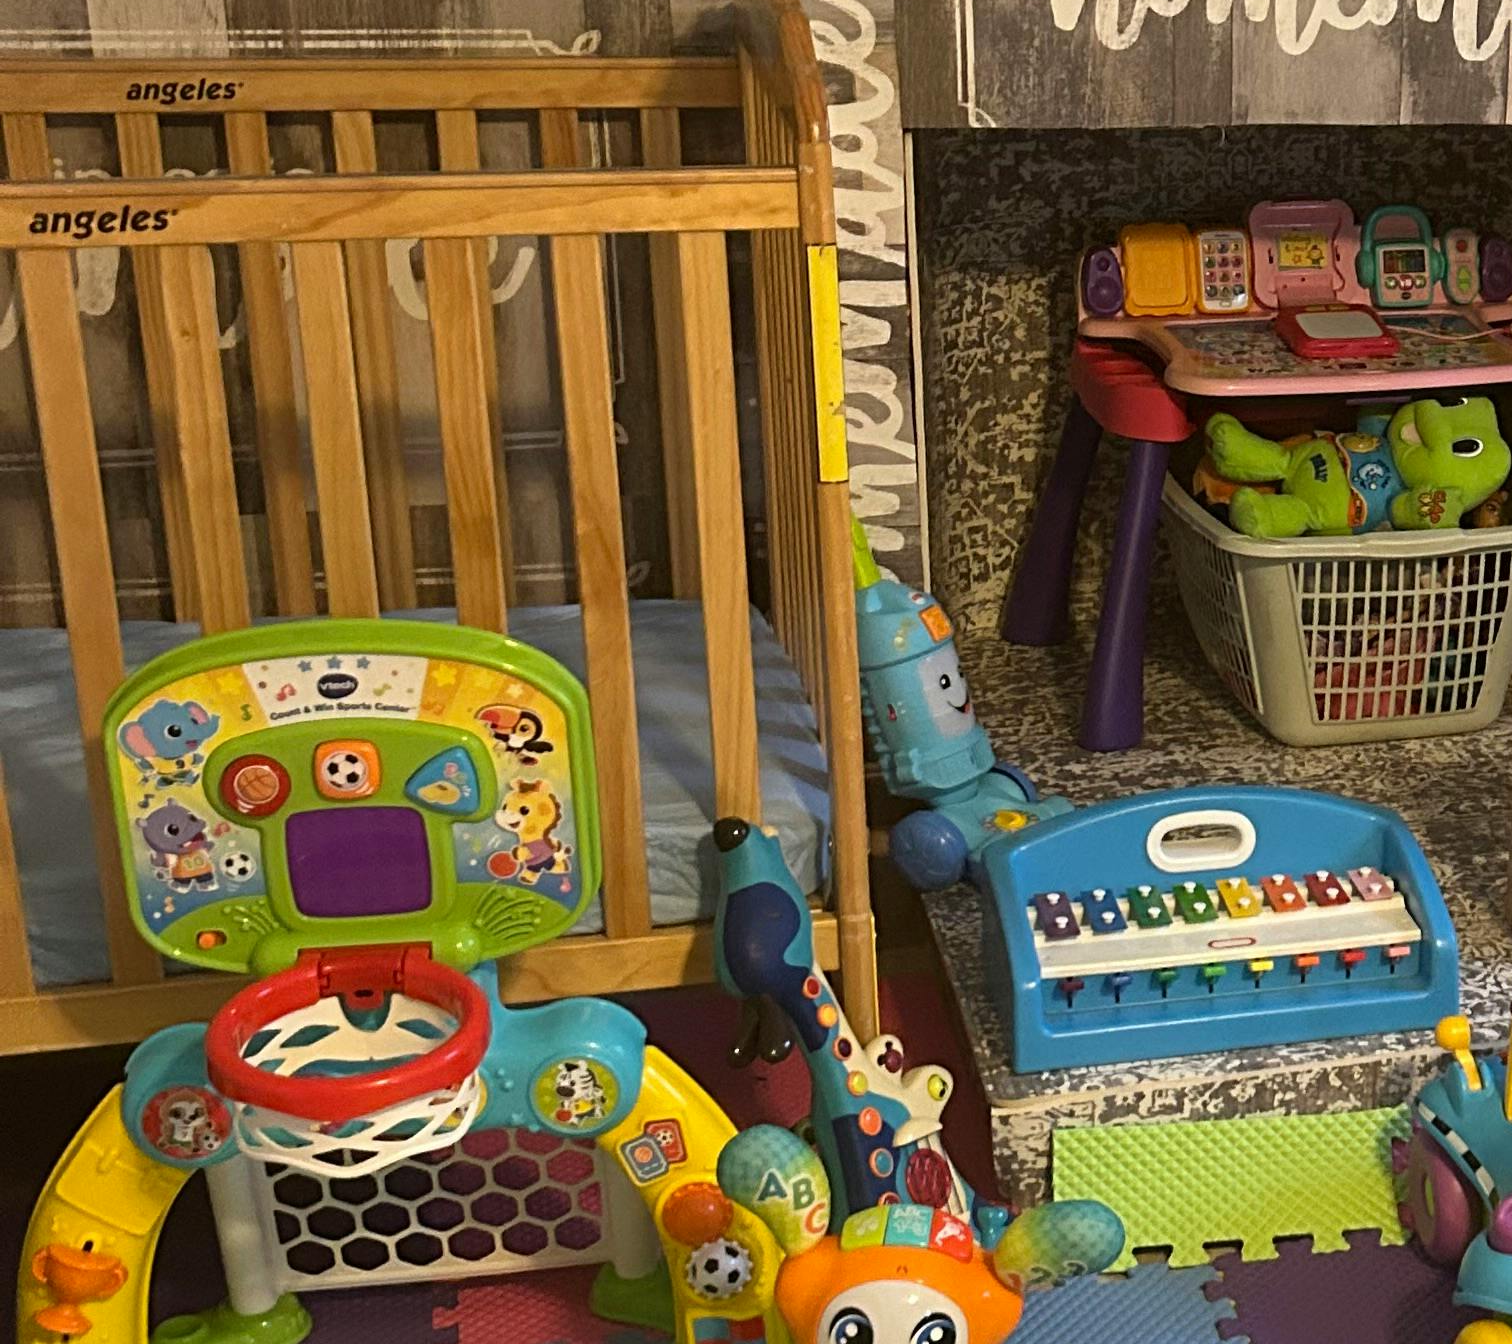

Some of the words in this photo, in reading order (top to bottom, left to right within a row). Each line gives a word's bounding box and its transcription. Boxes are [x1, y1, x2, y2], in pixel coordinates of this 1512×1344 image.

[126, 78, 238, 105] angeles
[28, 204, 170, 240] angeles
[269, 707, 302, 721] Count
[314, 703, 335, 713] Win
[336, 702, 373, 711] Sports
[374, 702, 410, 713] Center
